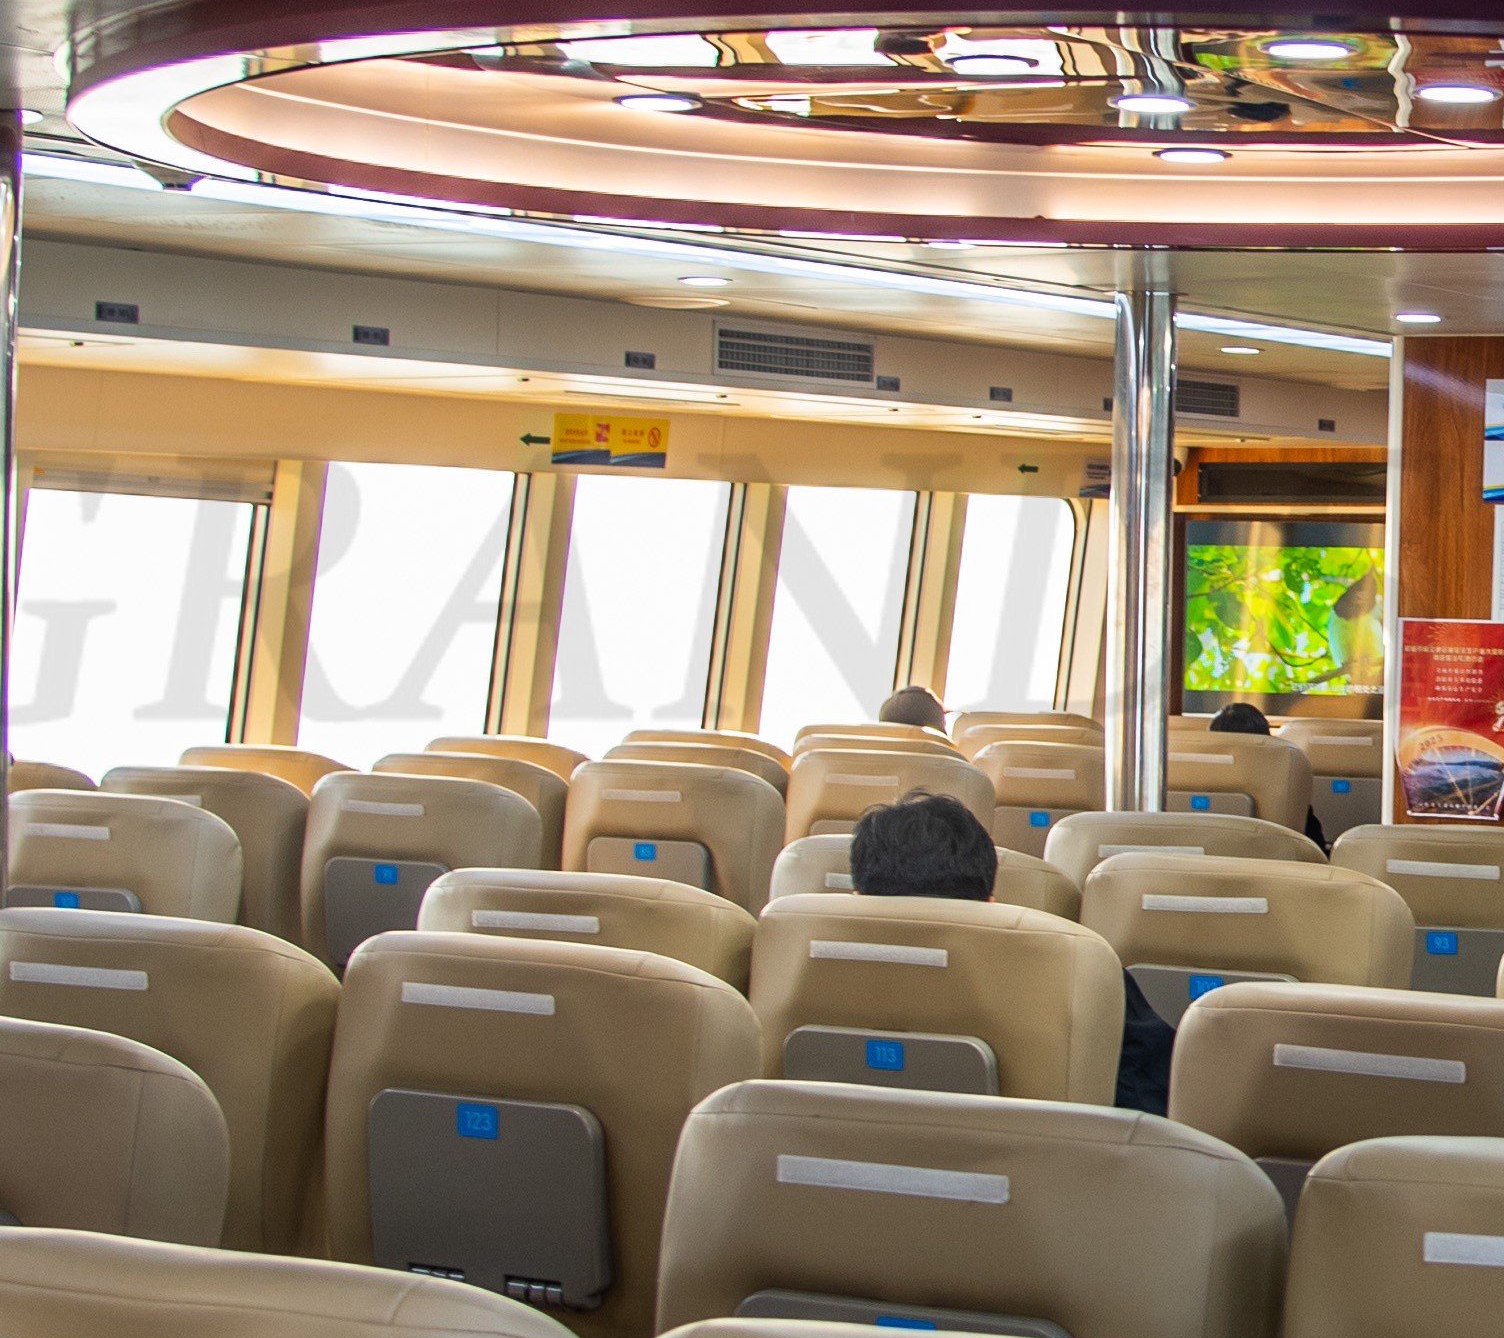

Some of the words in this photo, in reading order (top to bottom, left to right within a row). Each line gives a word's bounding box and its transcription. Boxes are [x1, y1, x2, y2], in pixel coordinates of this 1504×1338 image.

[1433, 936, 1450, 950] 93
[874, 1045, 897, 1063] 113
[466, 1111, 491, 1131] 123
